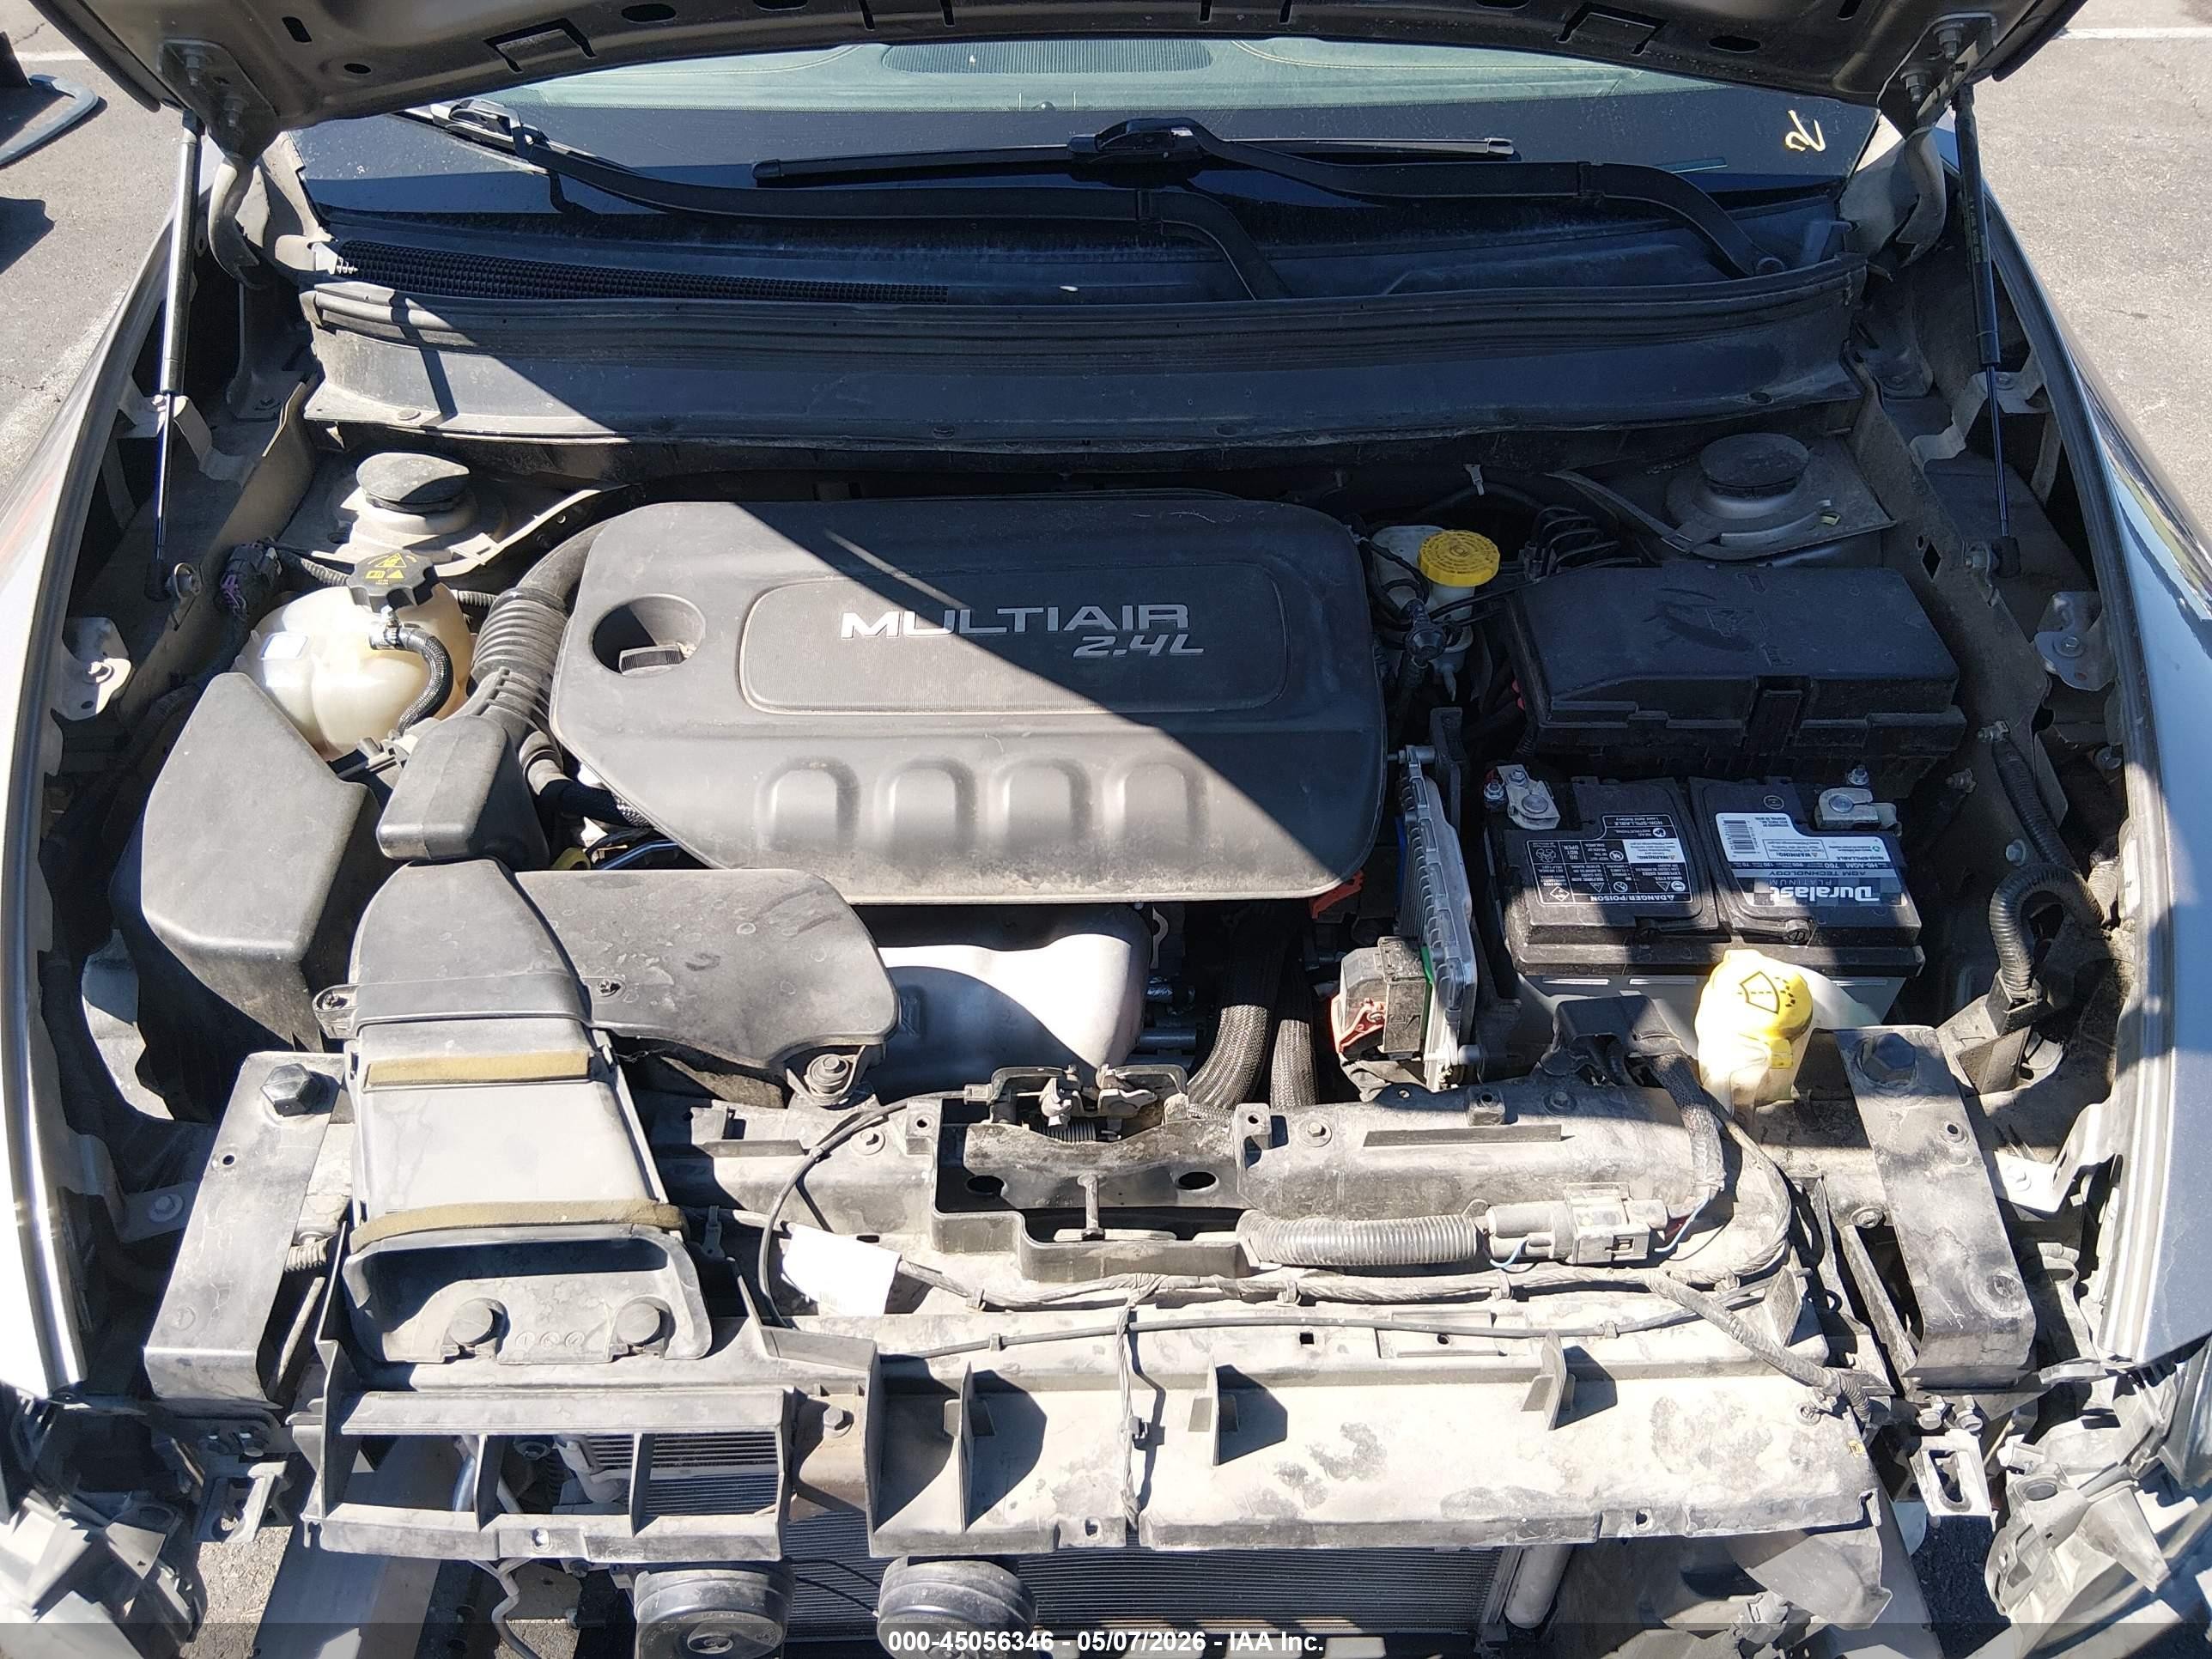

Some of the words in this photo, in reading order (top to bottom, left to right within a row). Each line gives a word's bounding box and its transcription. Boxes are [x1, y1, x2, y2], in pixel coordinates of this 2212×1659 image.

[841, 604, 1188, 639] MULTIAIR
[1073, 634, 1204, 659] 2.4L
[1768, 878, 1832, 886] PLATINUM
[1768, 885, 1880, 902] Duralast
